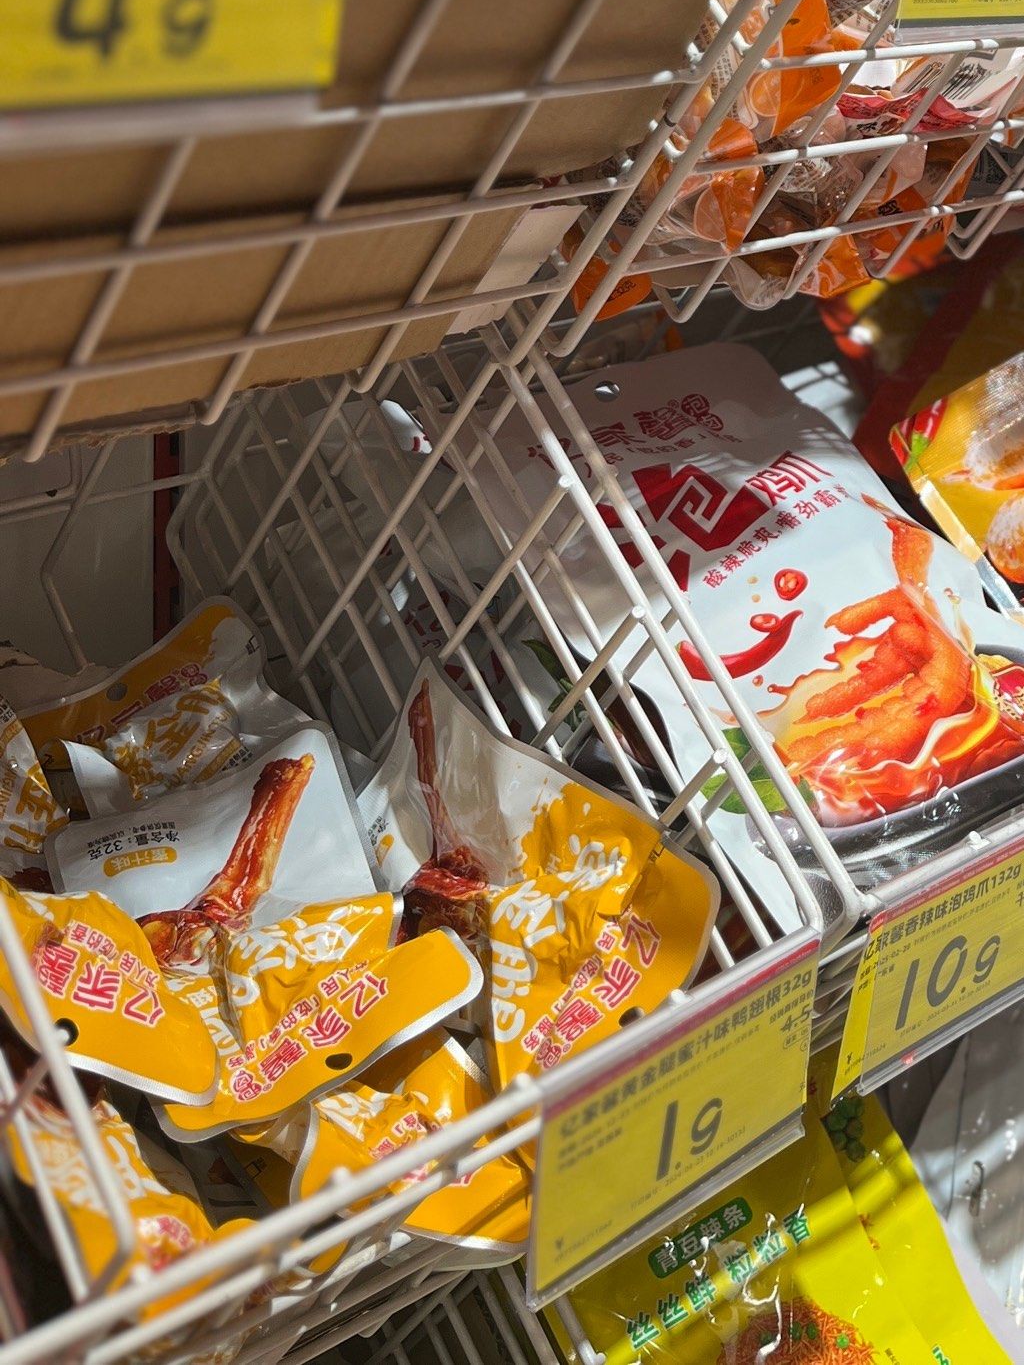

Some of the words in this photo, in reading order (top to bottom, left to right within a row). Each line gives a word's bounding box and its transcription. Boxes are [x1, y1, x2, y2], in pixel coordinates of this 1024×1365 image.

[745, 450, 837, 506] 鸡爪
[111, 849, 170, 872] 蜜汁味
[863, 862, 1022, 962] 亿家馨香辣味泡鸡爪132g
[556, 914, 661, 1042] 亿家馨
[894, 934, 1001, 1032] 10.9
[258, 971, 389, 1087] 亿家馨
[656, 1097, 723, 1182] 1.9
